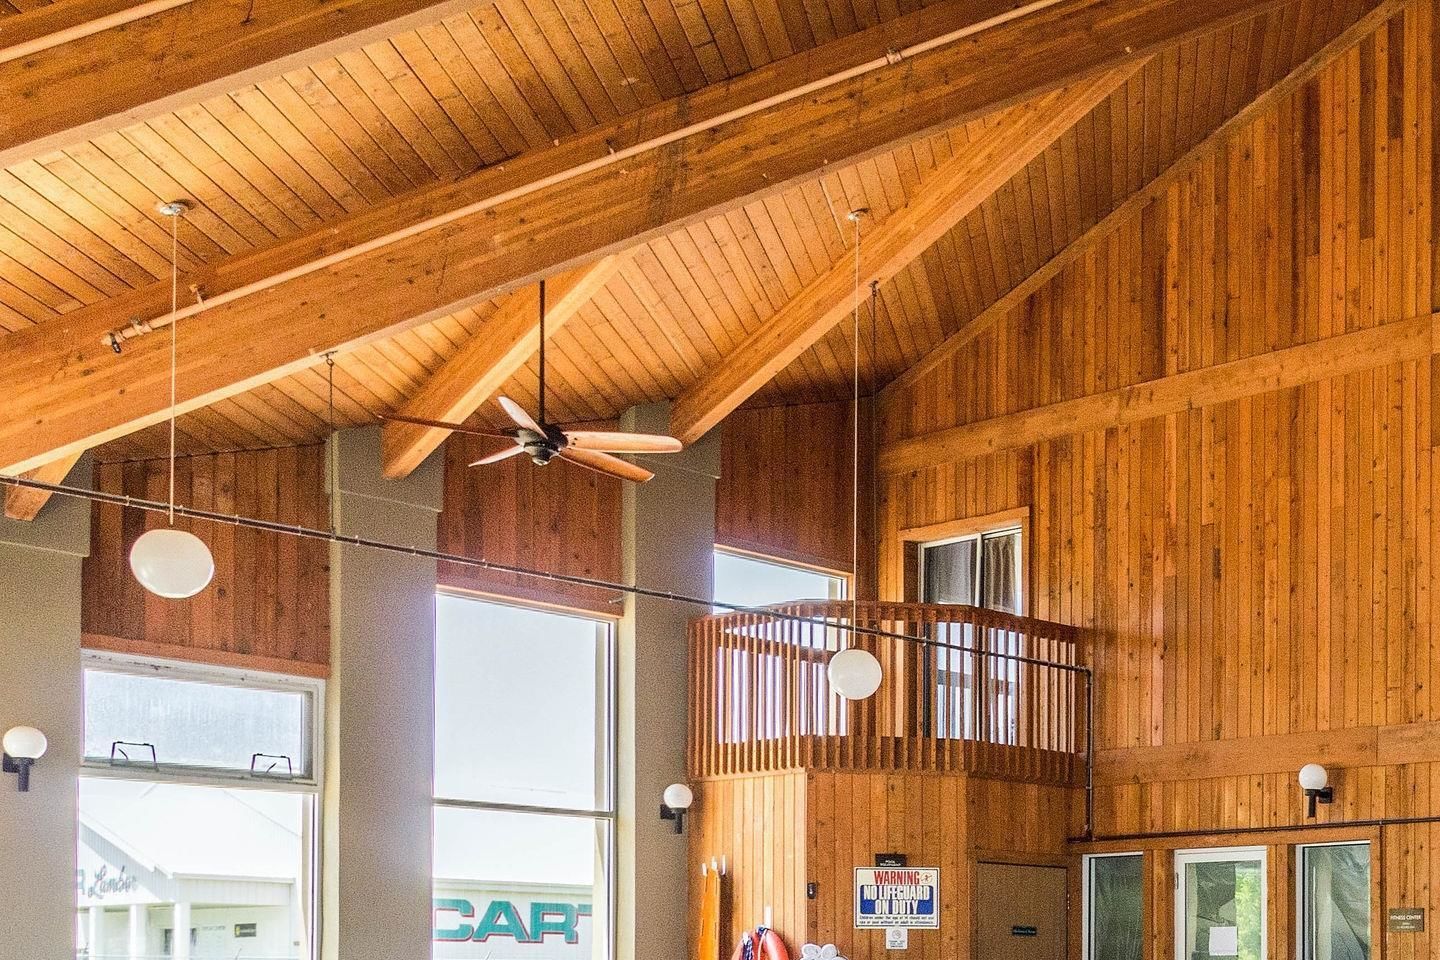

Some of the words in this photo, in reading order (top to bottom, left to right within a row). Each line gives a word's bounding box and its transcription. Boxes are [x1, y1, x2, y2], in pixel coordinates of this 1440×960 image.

[874, 871, 920, 884] WARNING
[864, 885, 877, 900] NO
[879, 885, 930, 900] LIFEGUARD
[875, 900, 889, 914] ON
[893, 900, 919, 914] DUTY
